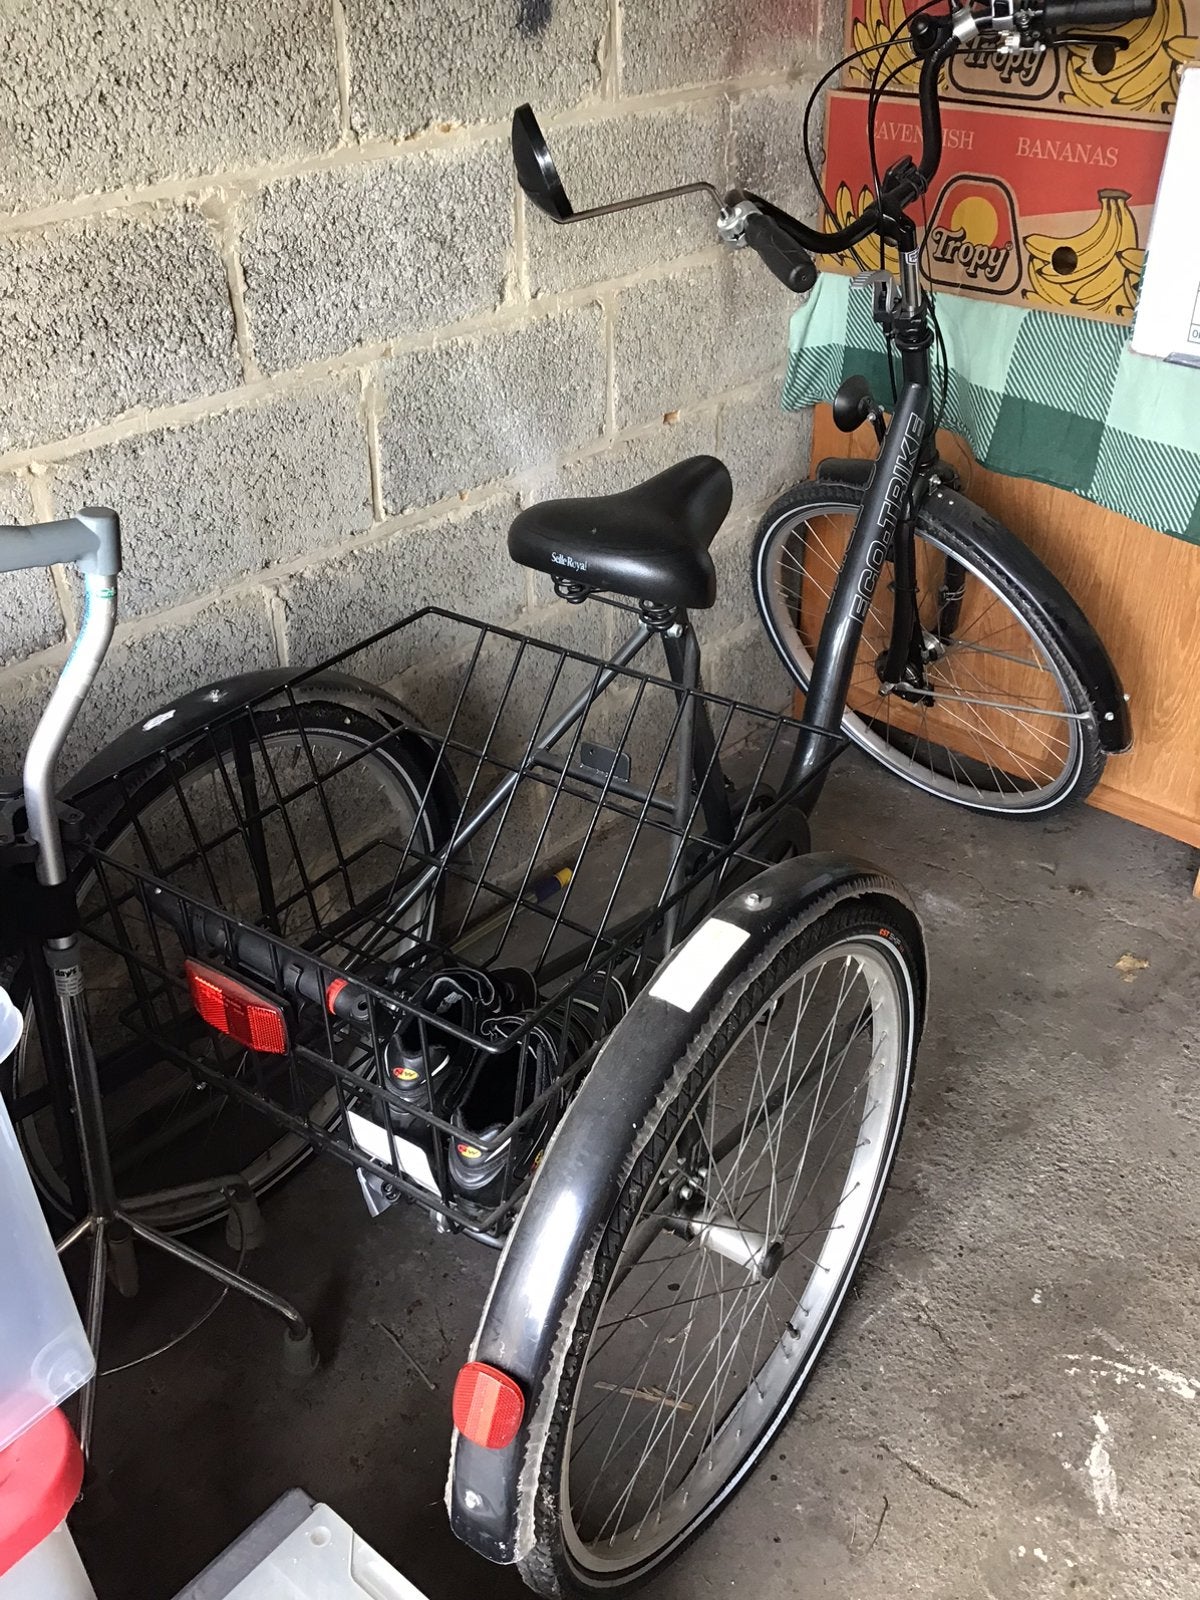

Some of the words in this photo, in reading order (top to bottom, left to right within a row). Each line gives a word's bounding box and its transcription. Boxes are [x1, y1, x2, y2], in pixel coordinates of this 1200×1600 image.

[1016, 136, 1119, 168] BANANAS
[931, 226, 1010, 282] Tropy
[849, 411, 926, 625] ECO-TRIKE
